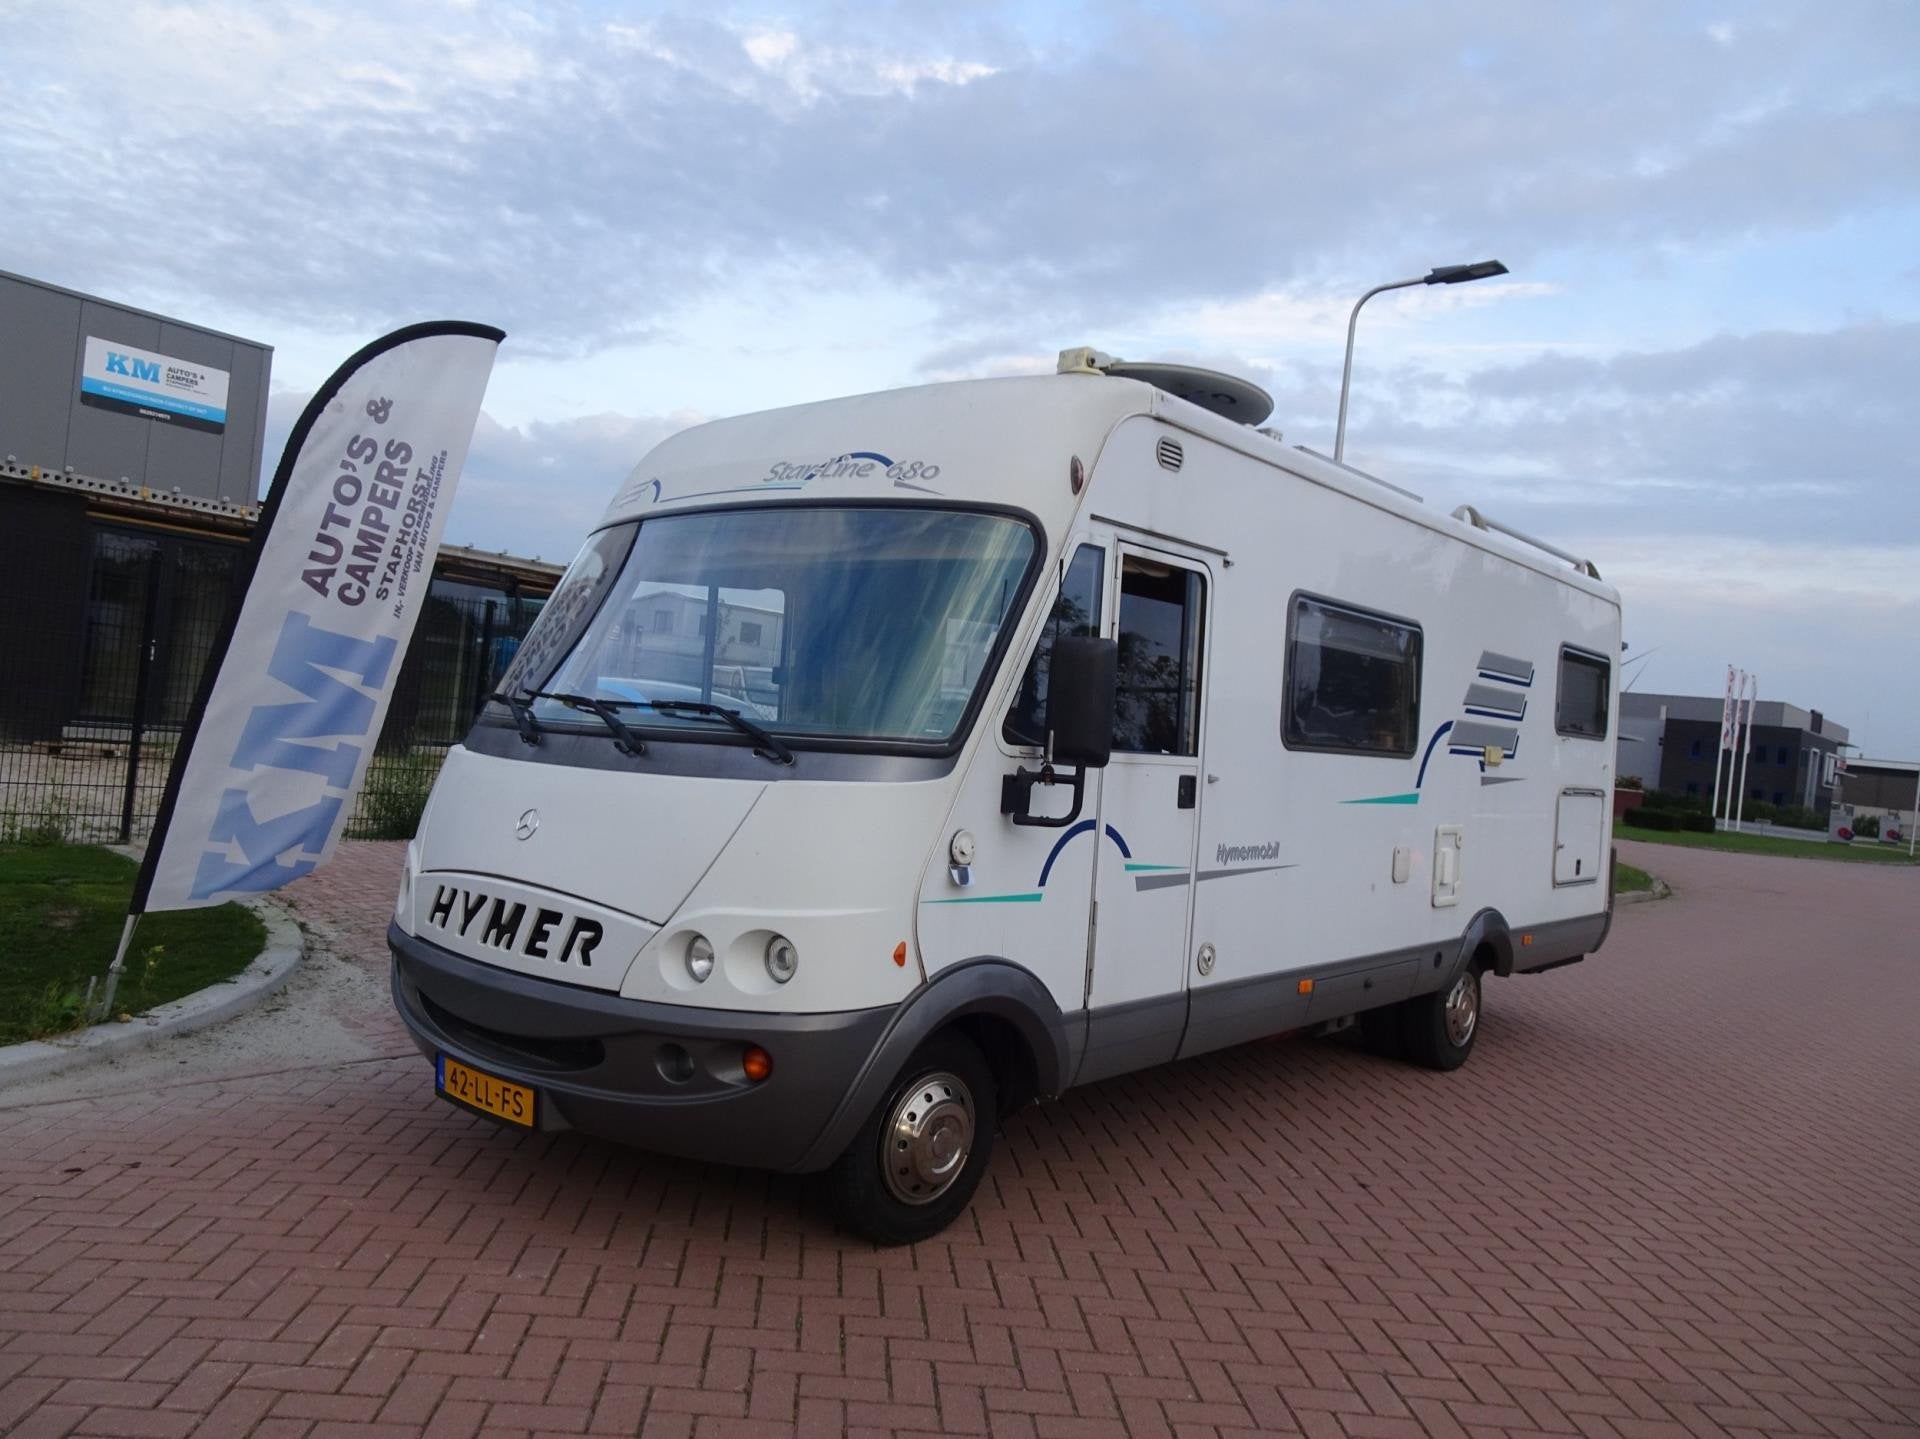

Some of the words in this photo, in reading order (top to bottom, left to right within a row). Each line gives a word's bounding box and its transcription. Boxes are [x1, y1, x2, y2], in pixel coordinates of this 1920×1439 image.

[105, 351, 162, 384] KM
[166, 374, 198, 386] CAMPERS
[167, 366, 198, 379] AUTO'S
[301, 434, 378, 598] AUTO'S
[366, 396, 394, 424] &
[413, 550, 424, 573] VAN
[420, 509, 433, 550] AUTO'S
[432, 450, 448, 500] CAMPERS
[886, 460, 942, 481] 680
[337, 438, 413, 606] CAMPERS
[376, 467, 429, 600] STAPHORST
[397, 546, 414, 597] VERKOOP
[411, 529, 420, 546] EN
[416, 455, 438, 528] BEMIDDELING
[187, 610, 398, 900] KM
[1216, 841, 1280, 866] Hymermobil
[426, 884, 604, 967] HYMER
[449, 1067, 524, 1117] 42-LL-FS
